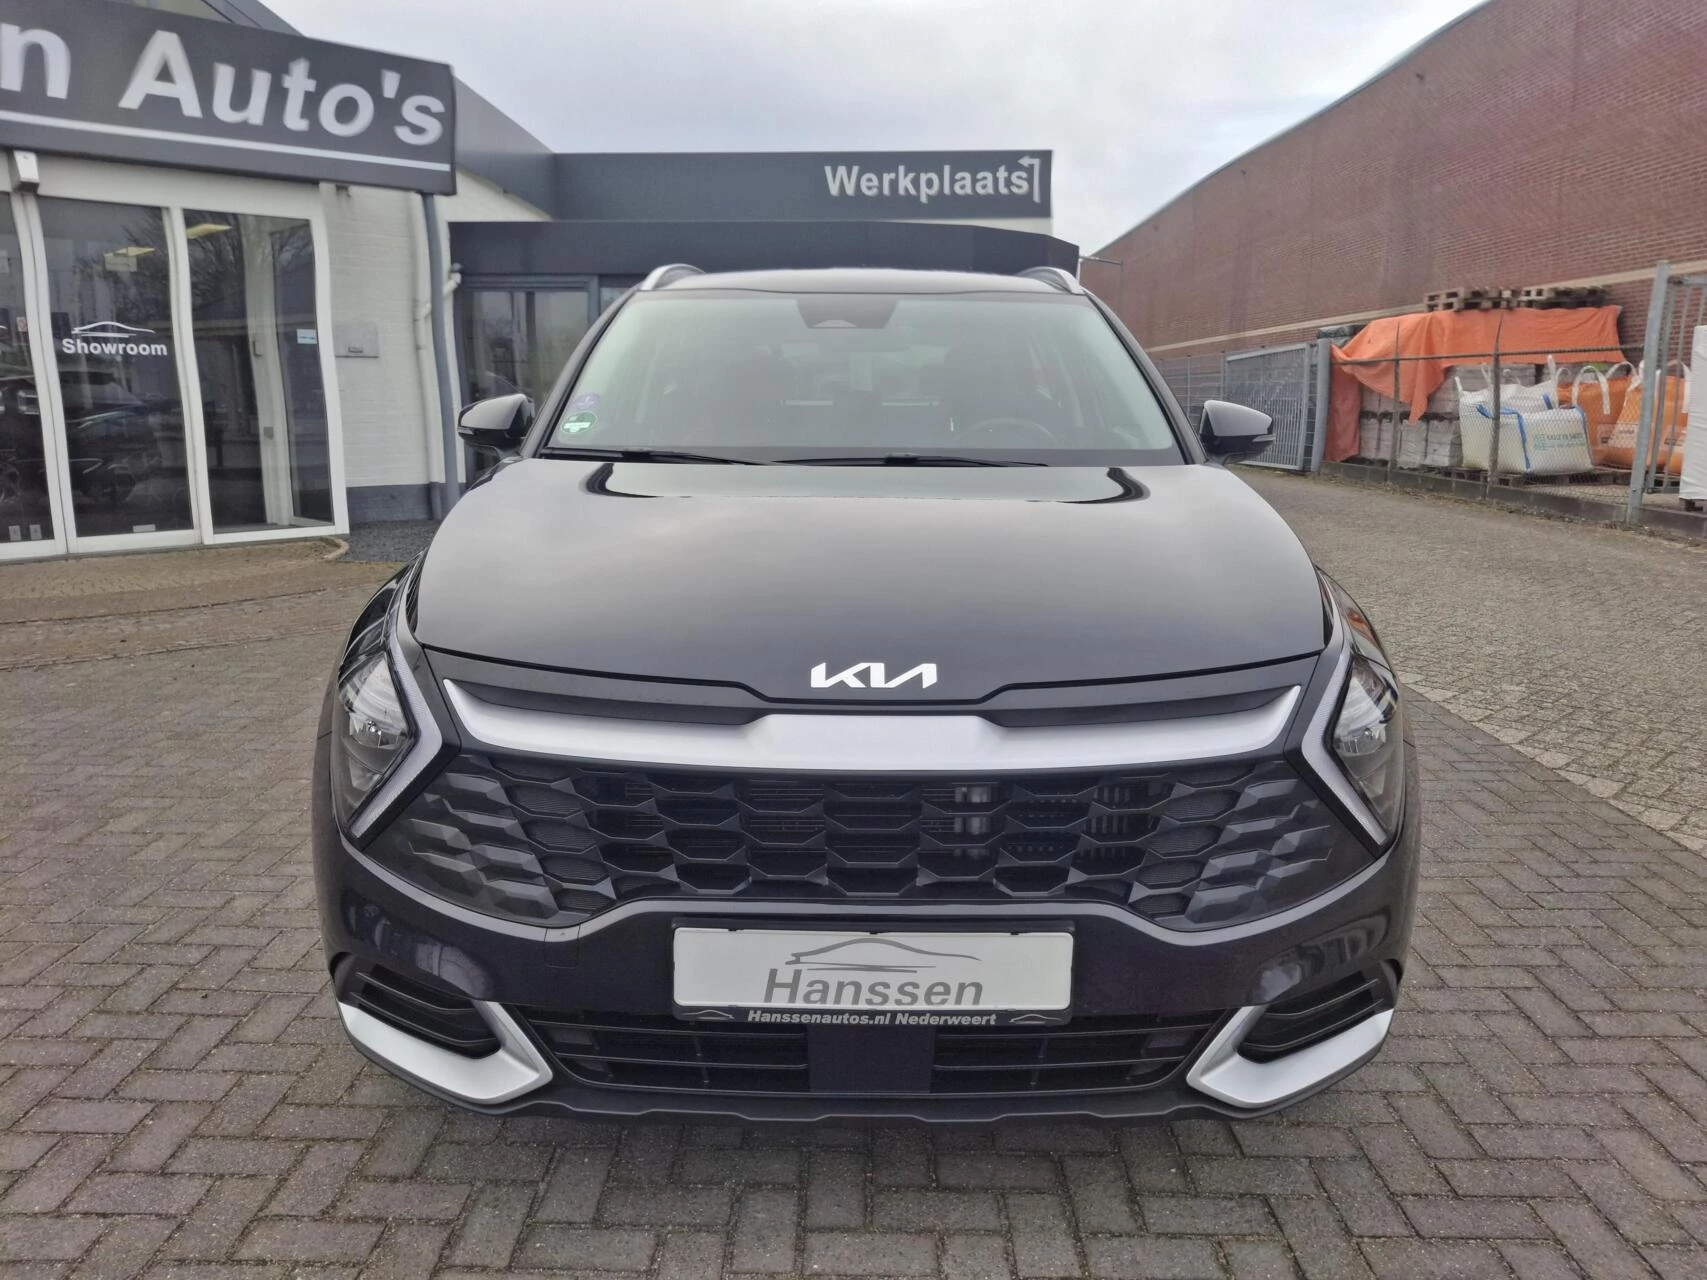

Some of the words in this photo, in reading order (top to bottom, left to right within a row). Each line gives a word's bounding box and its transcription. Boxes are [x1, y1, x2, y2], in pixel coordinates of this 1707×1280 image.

[118, 30, 445, 146] Auto's
[824, 164, 1029, 204] Werkplaats
[61, 338, 168, 356] Showroom
[811, 662, 937, 688] KIA
[764, 968, 983, 1006] Hanssen
[747, 1010, 891, 1025] Hanssenautos.nl
[895, 1013, 997, 1025] Nederweert
